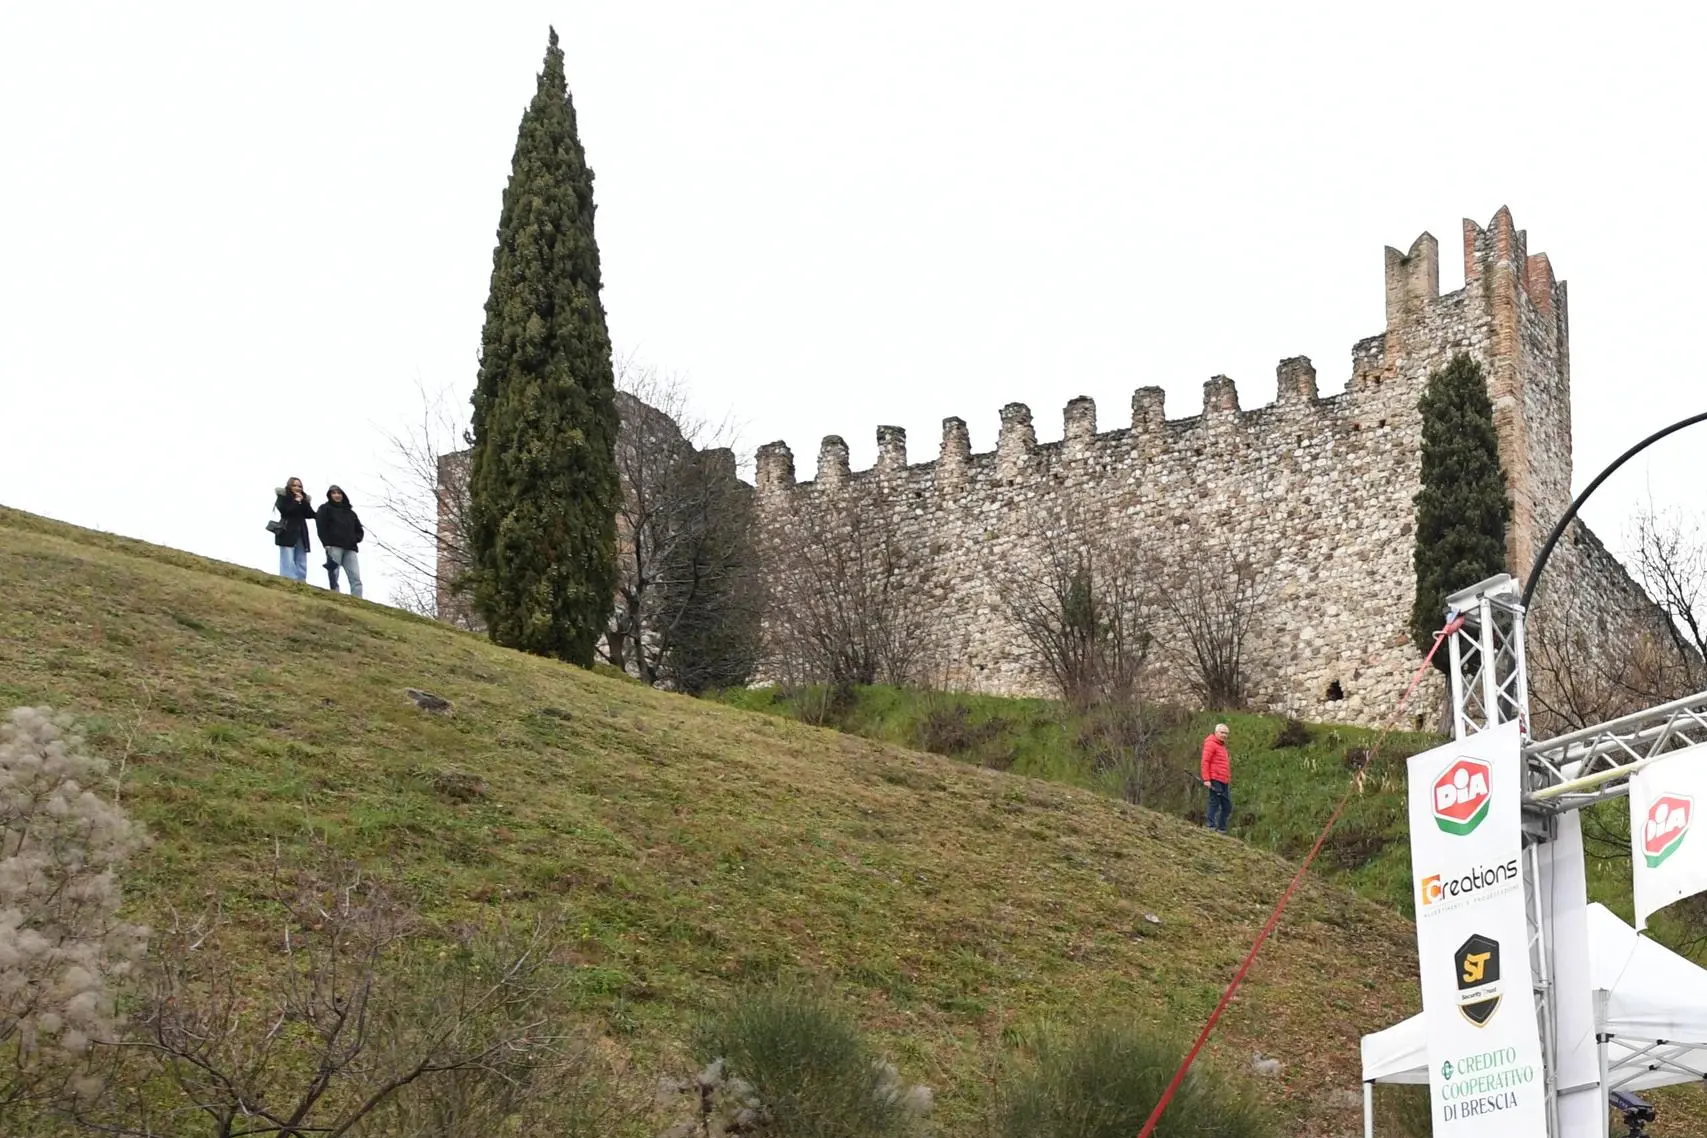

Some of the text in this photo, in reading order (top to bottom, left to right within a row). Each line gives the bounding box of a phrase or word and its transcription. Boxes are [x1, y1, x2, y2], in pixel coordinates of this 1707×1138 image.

[1422, 859, 1518, 905] Creations
[1463, 951, 1491, 982] ST
[1457, 1047, 1516, 1075] CREDITO
[1441, 1065, 1534, 1101] COOPERATIVO
[1443, 1092, 1518, 1122] DI BRESCIA
